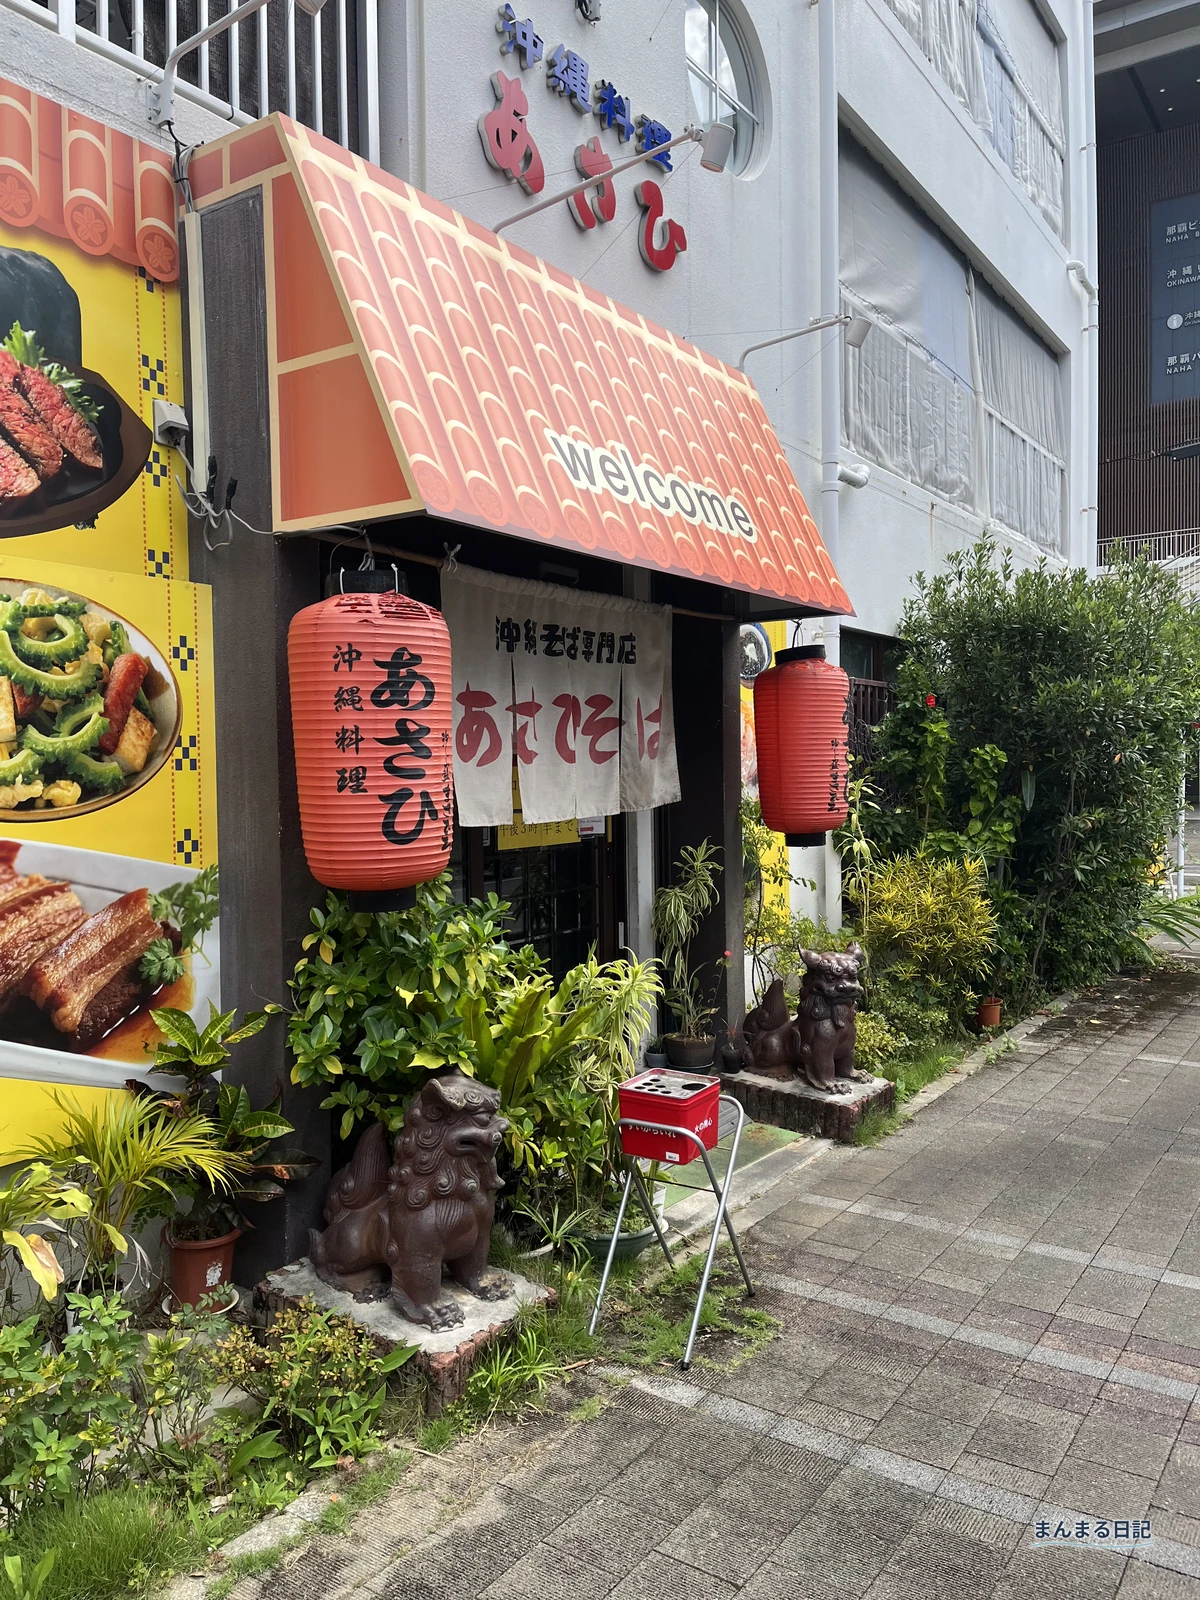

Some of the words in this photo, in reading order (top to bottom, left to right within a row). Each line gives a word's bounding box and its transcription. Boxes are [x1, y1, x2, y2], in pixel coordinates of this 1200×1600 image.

[495, 3, 673, 172] 沖縄料理
[477, 70, 687, 271] あさひ
[1166, 220, 1200, 235] 那覇ビ
[1166, 234, 1189, 243] NAHA
[1166, 364, 1192, 374] NAHA
[550, 434, 755, 538] welcome
[495, 615, 637, 664] 沖縄そば専門店
[332, 643, 368, 794] 沖縄料理
[370, 646, 439, 845] あさひ
